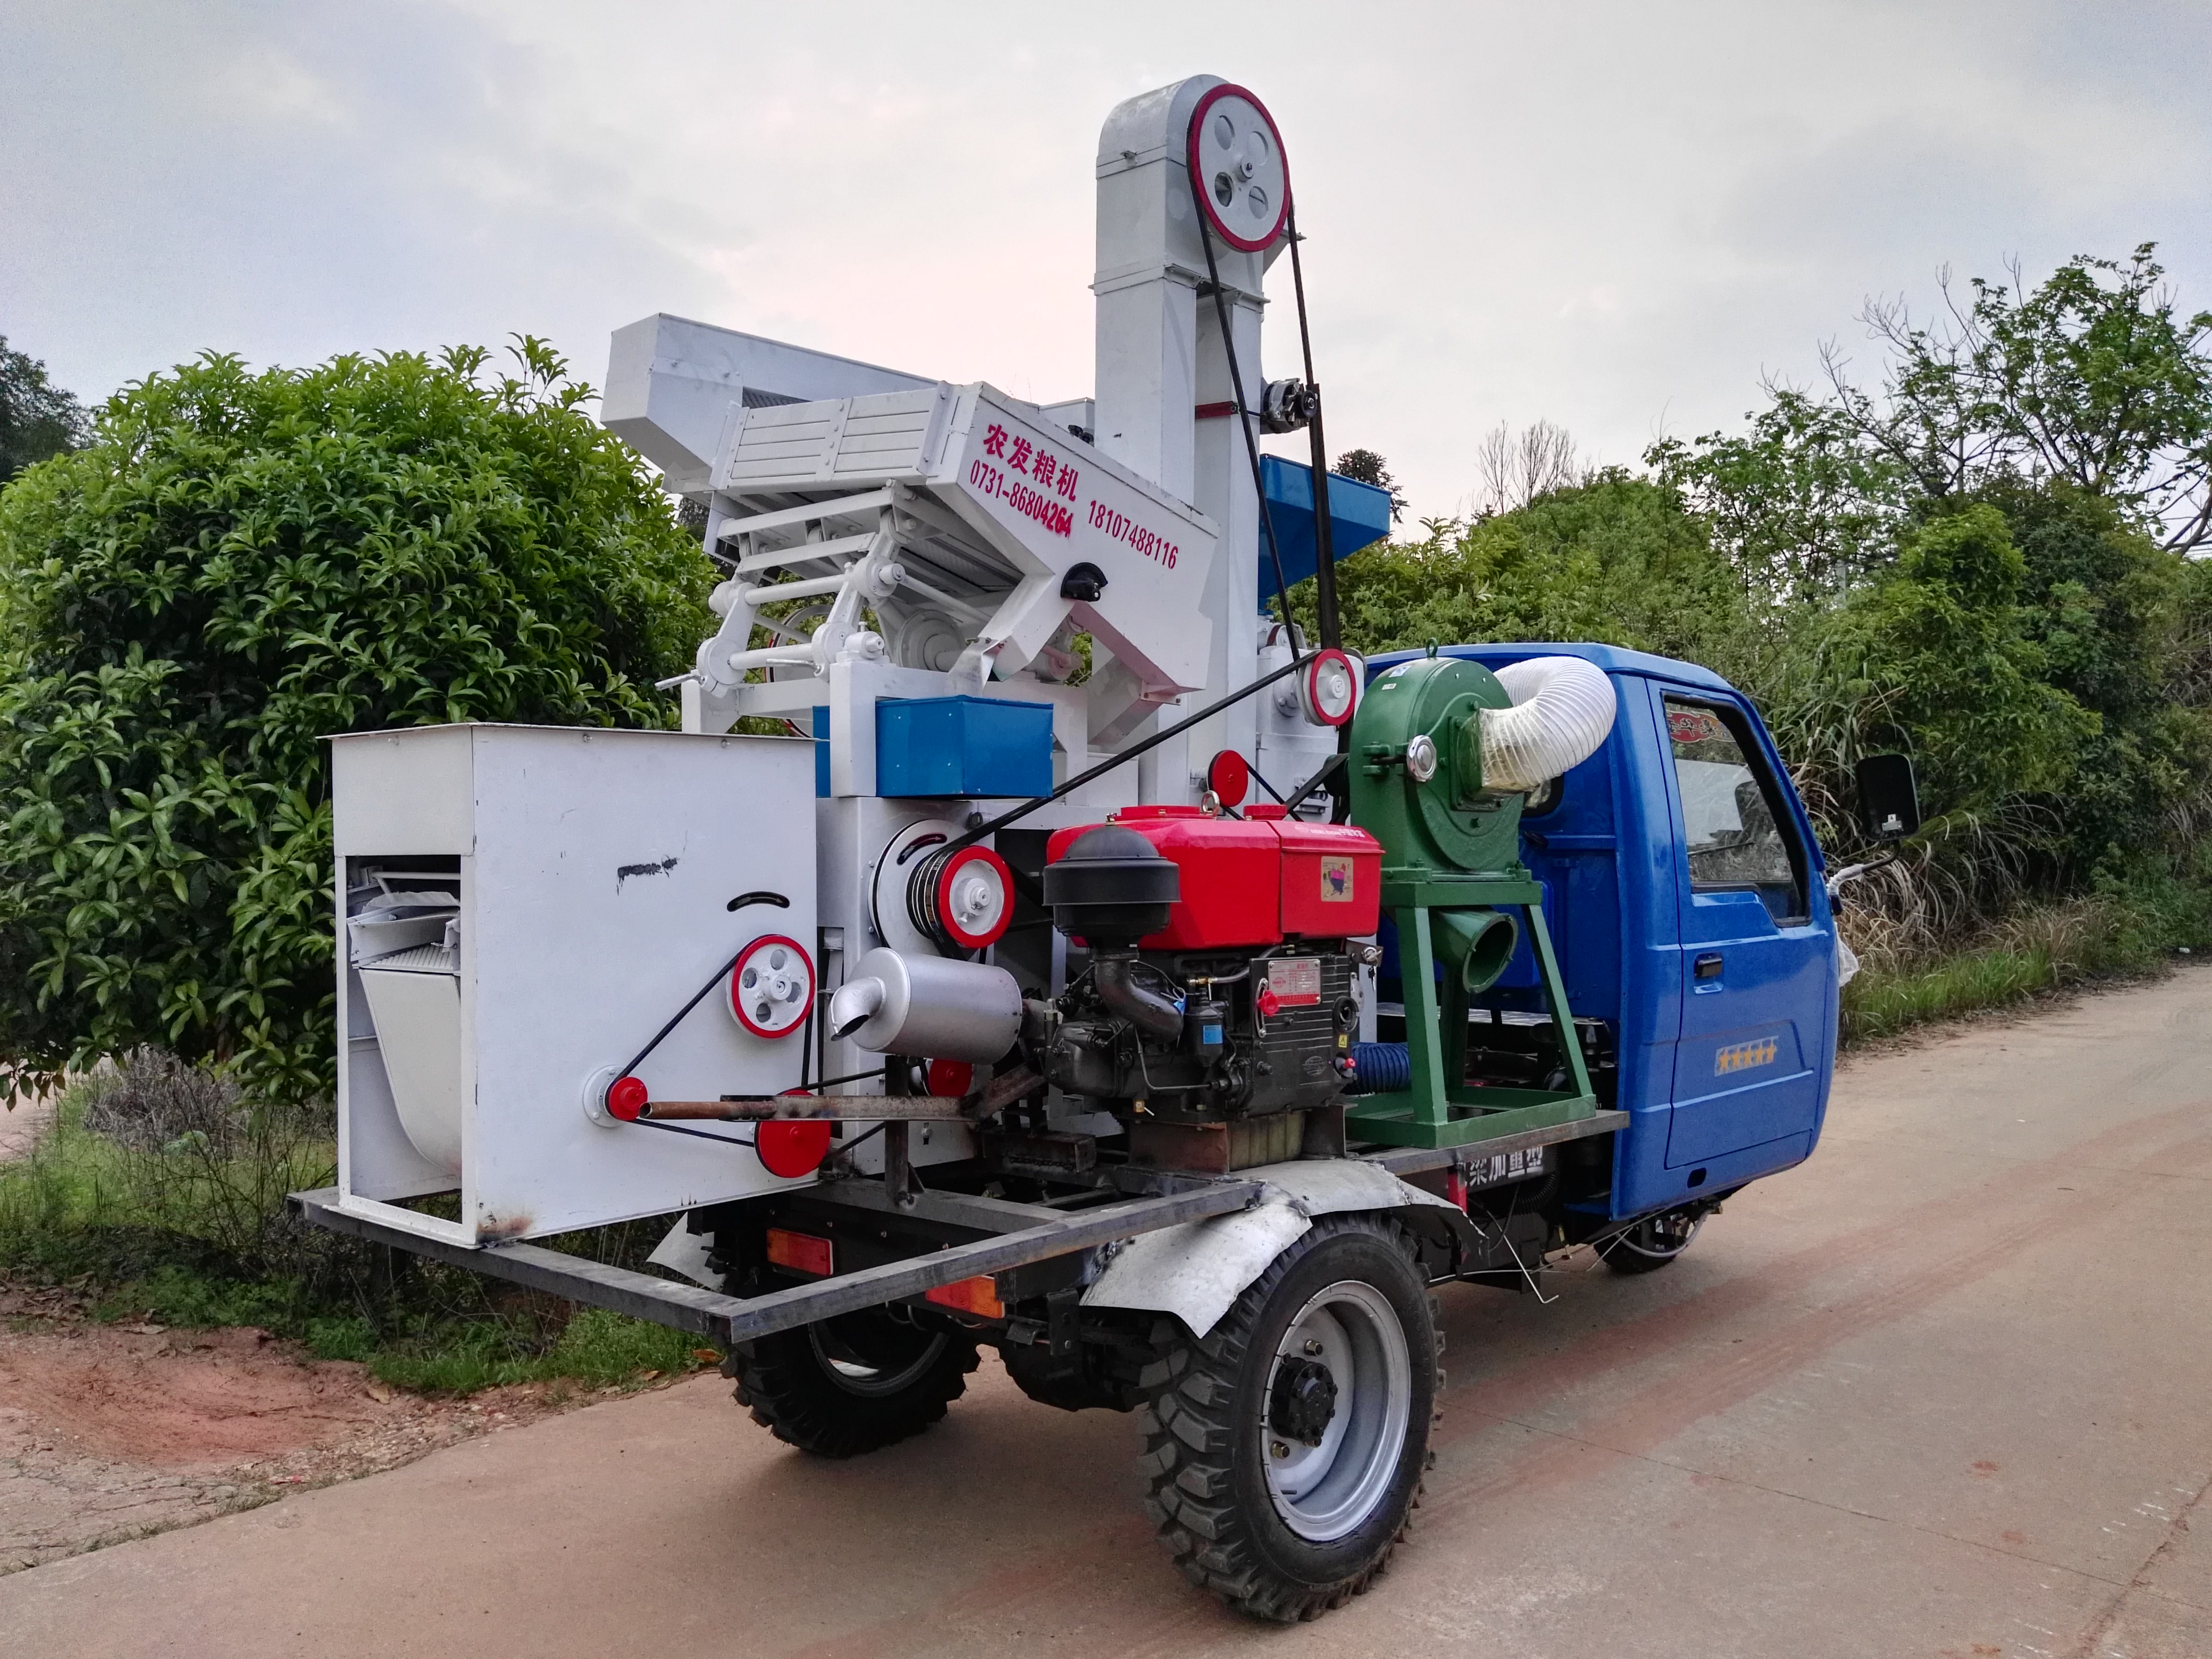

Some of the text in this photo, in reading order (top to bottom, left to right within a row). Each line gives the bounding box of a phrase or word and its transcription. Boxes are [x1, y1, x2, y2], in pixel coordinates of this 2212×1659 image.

[970, 459, 1073, 538] 0731-86804264
[983, 424, 1079, 501] 农发粮机
[1088, 500, 1178, 569] 18107488116
[1464, 1146, 1543, 1187] 梁加重型
